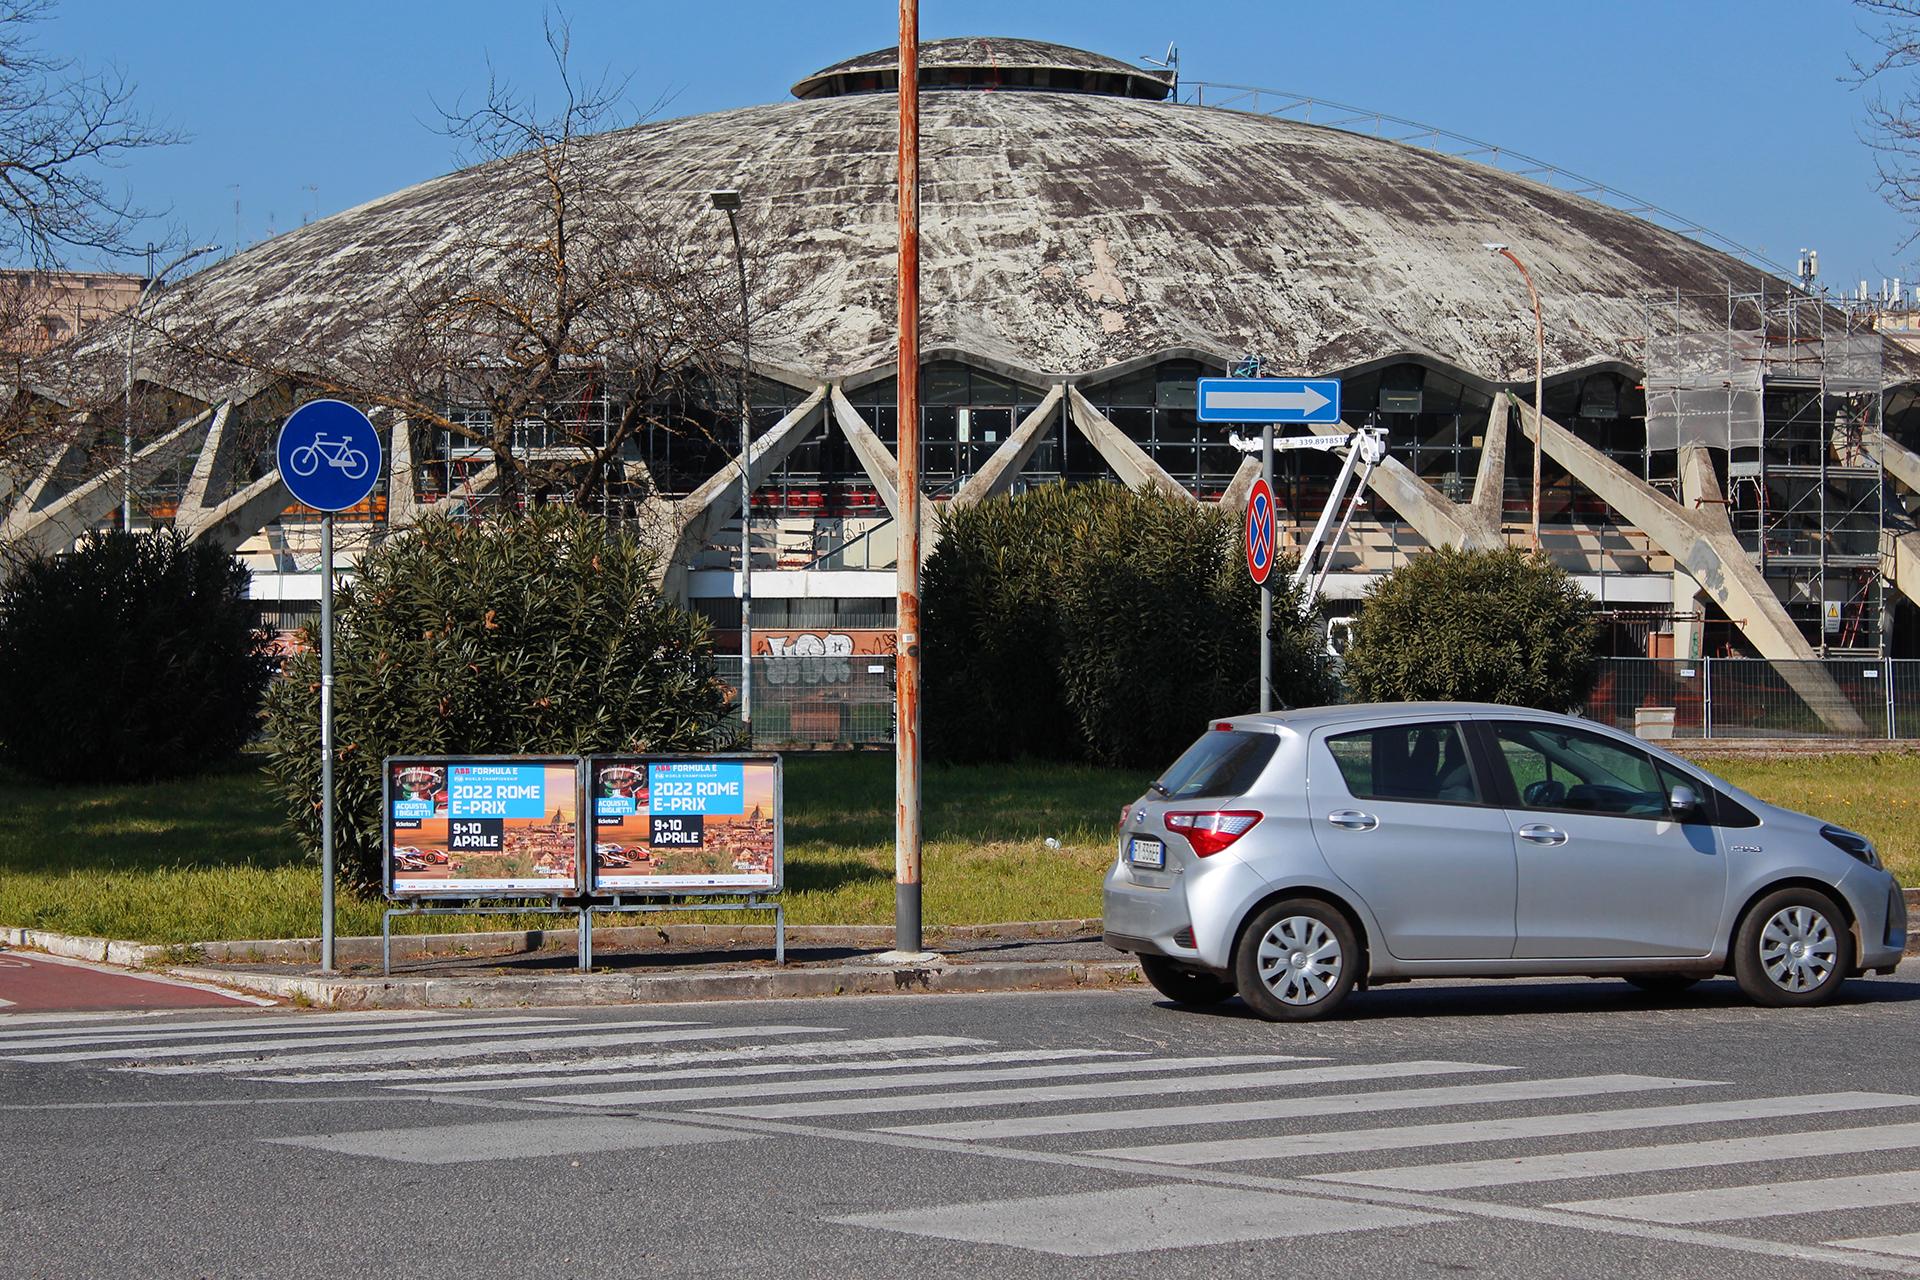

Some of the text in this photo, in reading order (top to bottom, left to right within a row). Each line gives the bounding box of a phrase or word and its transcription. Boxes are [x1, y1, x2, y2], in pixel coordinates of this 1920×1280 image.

[472, 767, 511, 775] FORMULA
[512, 767, 518, 775] E
[672, 764, 711, 772] FORMULA
[712, 764, 717, 772] E
[453, 785, 540, 799] 2022 ROME
[654, 782, 739, 796] 2022 ROME
[452, 801, 506, 815] E-PRIX
[653, 797, 706, 811] E-PRIX
[453, 823, 482, 834] 9+10
[654, 819, 682, 831] 9+10
[453, 835, 499, 847] APRILE
[654, 832, 699, 844] APRILE
